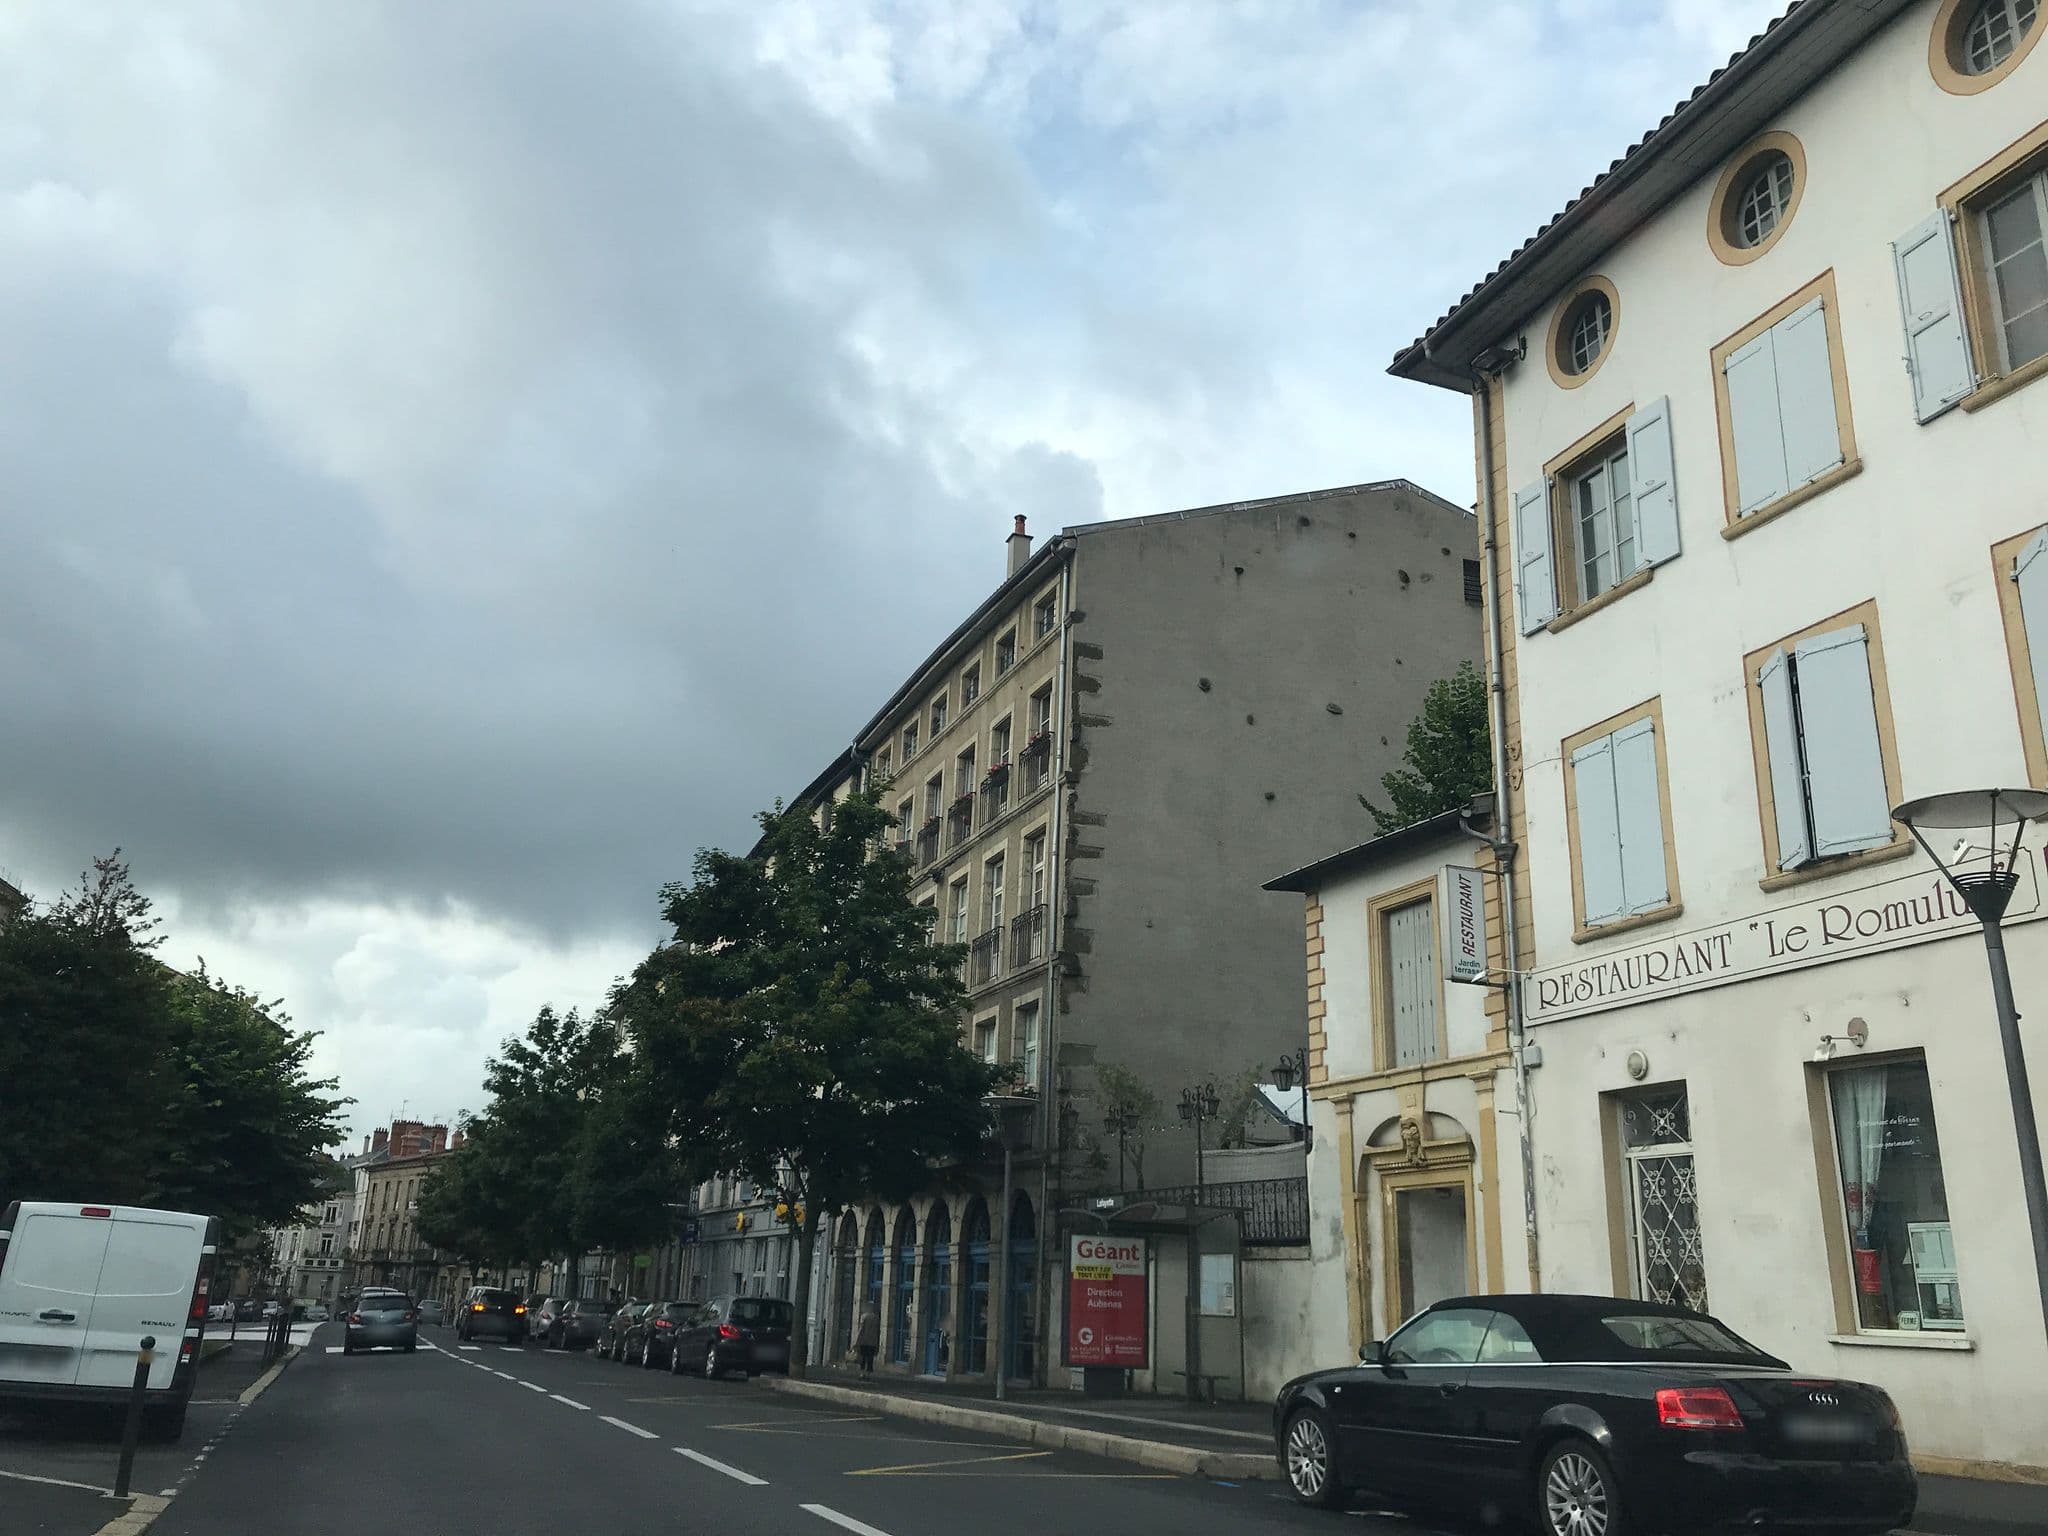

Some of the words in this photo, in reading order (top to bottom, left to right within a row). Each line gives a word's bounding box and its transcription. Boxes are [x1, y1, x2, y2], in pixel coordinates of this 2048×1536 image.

[1458, 873, 1475, 958] RESTAURANT
[1458, 959, 1481, 968] Jardin
[1538, 931, 1732, 1010] RESTAURANT
[1077, 1240, 1139, 1261] Géant
[1087, 1287, 1123, 1298] Direction
[141, 1320, 176, 1328] RENAULT
